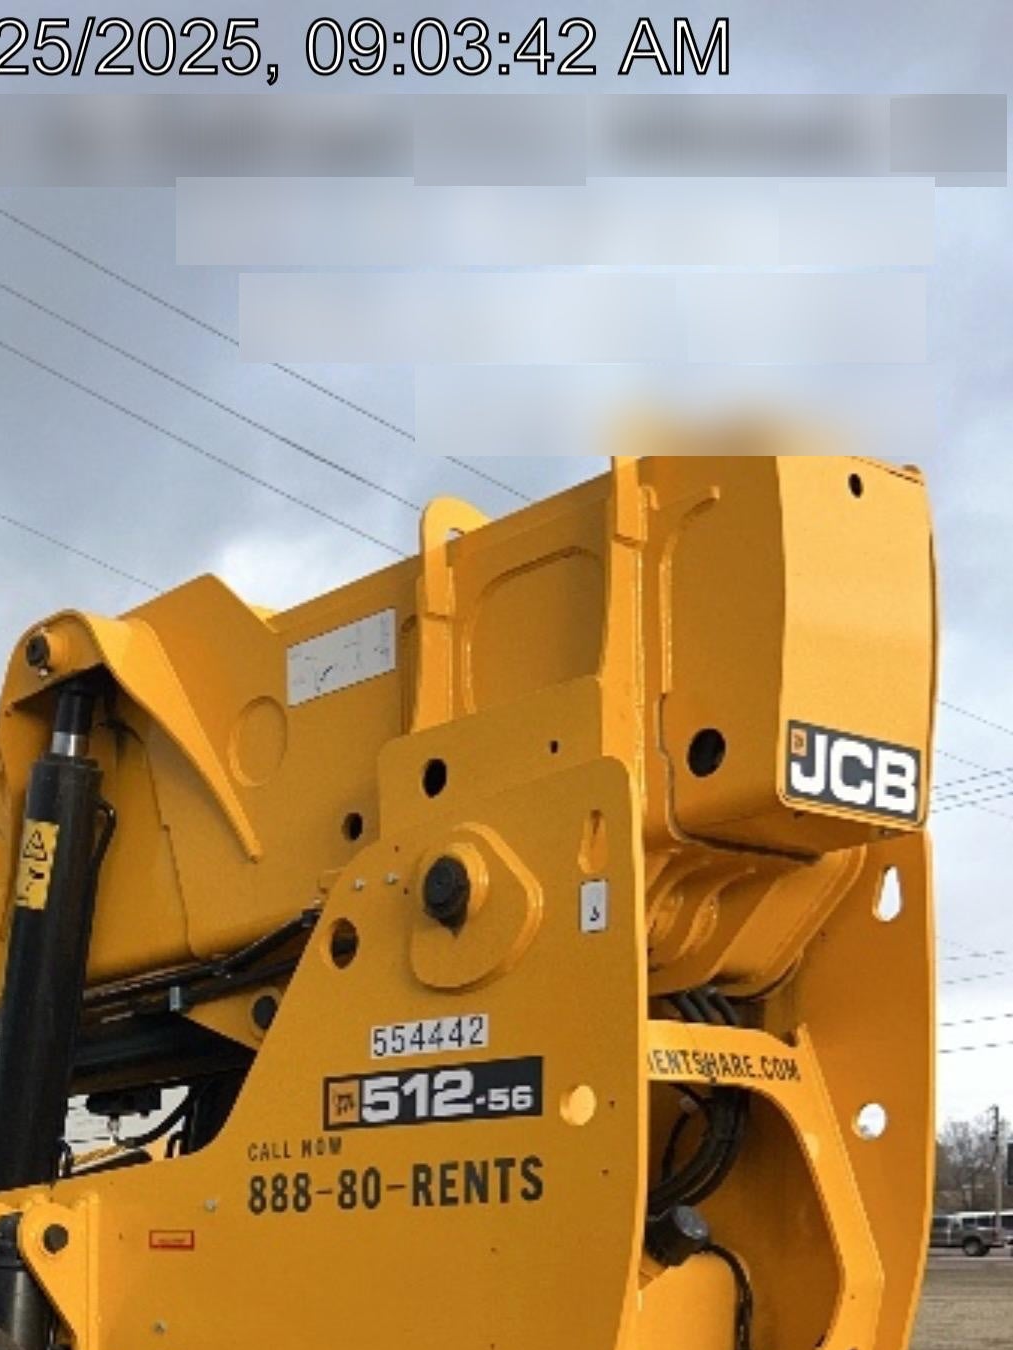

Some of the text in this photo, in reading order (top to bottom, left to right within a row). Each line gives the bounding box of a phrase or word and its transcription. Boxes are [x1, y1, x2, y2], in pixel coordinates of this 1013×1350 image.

[790, 733, 917, 813] JCB
[373, 1016, 484, 1057] 554442
[361, 1069, 534, 1123] 512-56
[248, 1137, 342, 1162] CALL NOW
[248, 1155, 544, 1215] 888-80-RENTS
